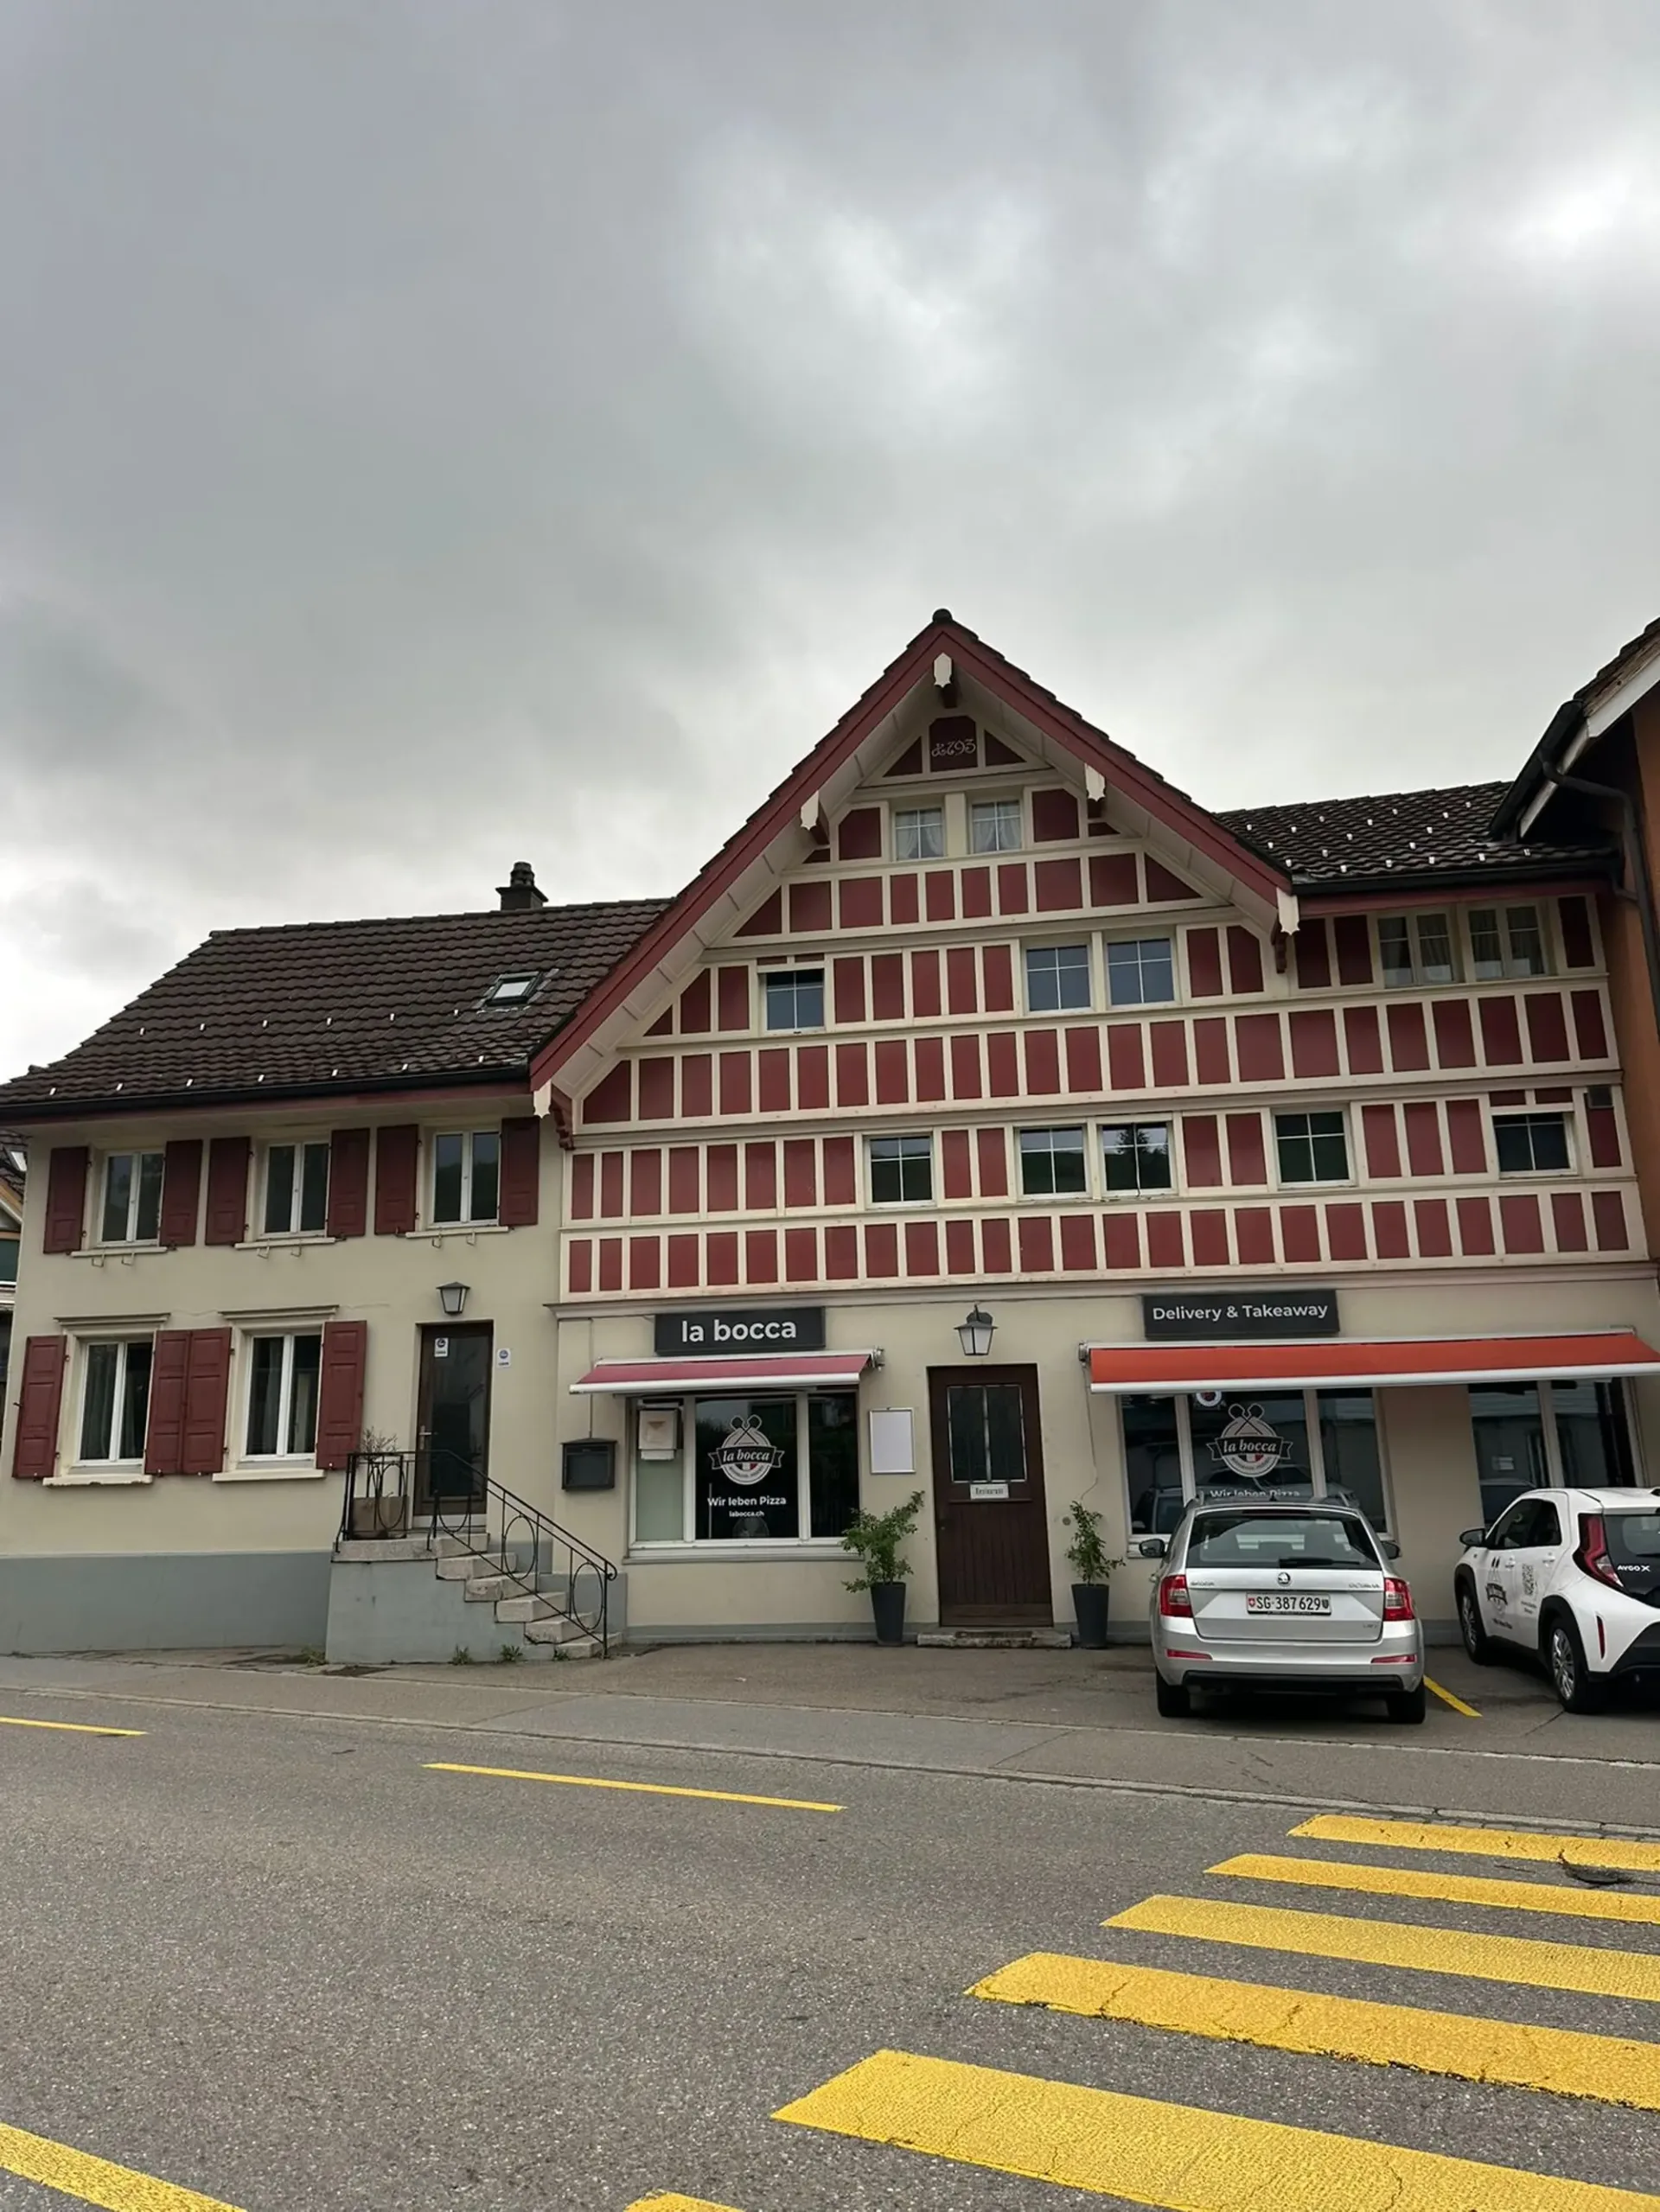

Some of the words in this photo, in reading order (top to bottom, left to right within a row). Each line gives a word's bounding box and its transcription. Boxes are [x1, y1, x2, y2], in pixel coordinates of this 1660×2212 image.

[1152, 1305, 1222, 1322] Delivery
[1226, 1305, 1238, 1318] &
[1242, 1304, 1328, 1318] Takeaway
[681, 1320, 704, 1342] la
[713, 1318, 797, 1342] bocca
[1223, 1439, 1236, 1453] la
[1239, 1438, 1277, 1452] bocca
[722, 1450, 734, 1463] la
[737, 1449, 770, 1461] bocca
[707, 1496, 726, 1507] Wir
[728, 1496, 757, 1507] leben
[759, 1495, 787, 1506] Pizza
